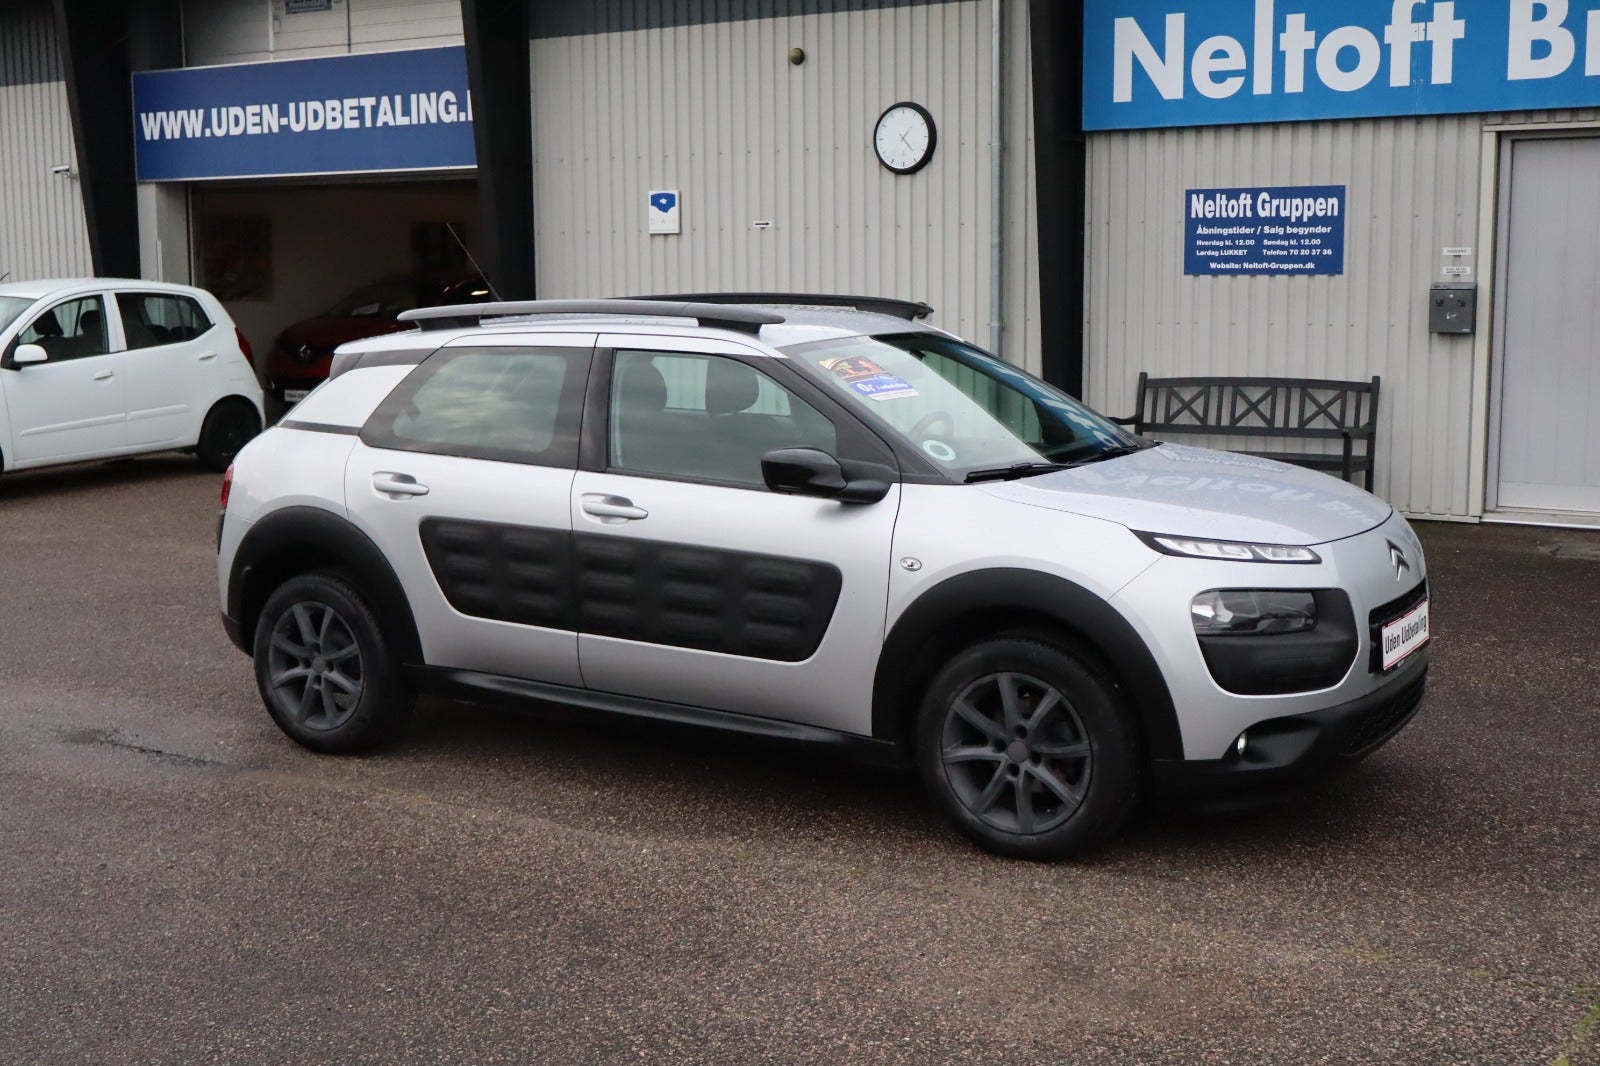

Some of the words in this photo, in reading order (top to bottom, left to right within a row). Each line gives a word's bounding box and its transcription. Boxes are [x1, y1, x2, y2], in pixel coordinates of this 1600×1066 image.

[1113, 0, 1466, 103] Neltoft
[140, 89, 473, 141] WWW.UDEN-UDBETALING.
[1191, 193, 1252, 218] Neltoft
[1257, 192, 1339, 222] Gruppen
[1196, 224, 1255, 235] Åbningstider
[1256, 226, 1261, 235] /
[1263, 226, 1284, 236] Salg
[1286, 225, 1332, 235] begynder
[1196, 239, 1224, 247] Hverdag
[1243, 262, 1315, 270] Neltoft-Gruppen.dk
[1385, 633, 1400, 654] Uden
